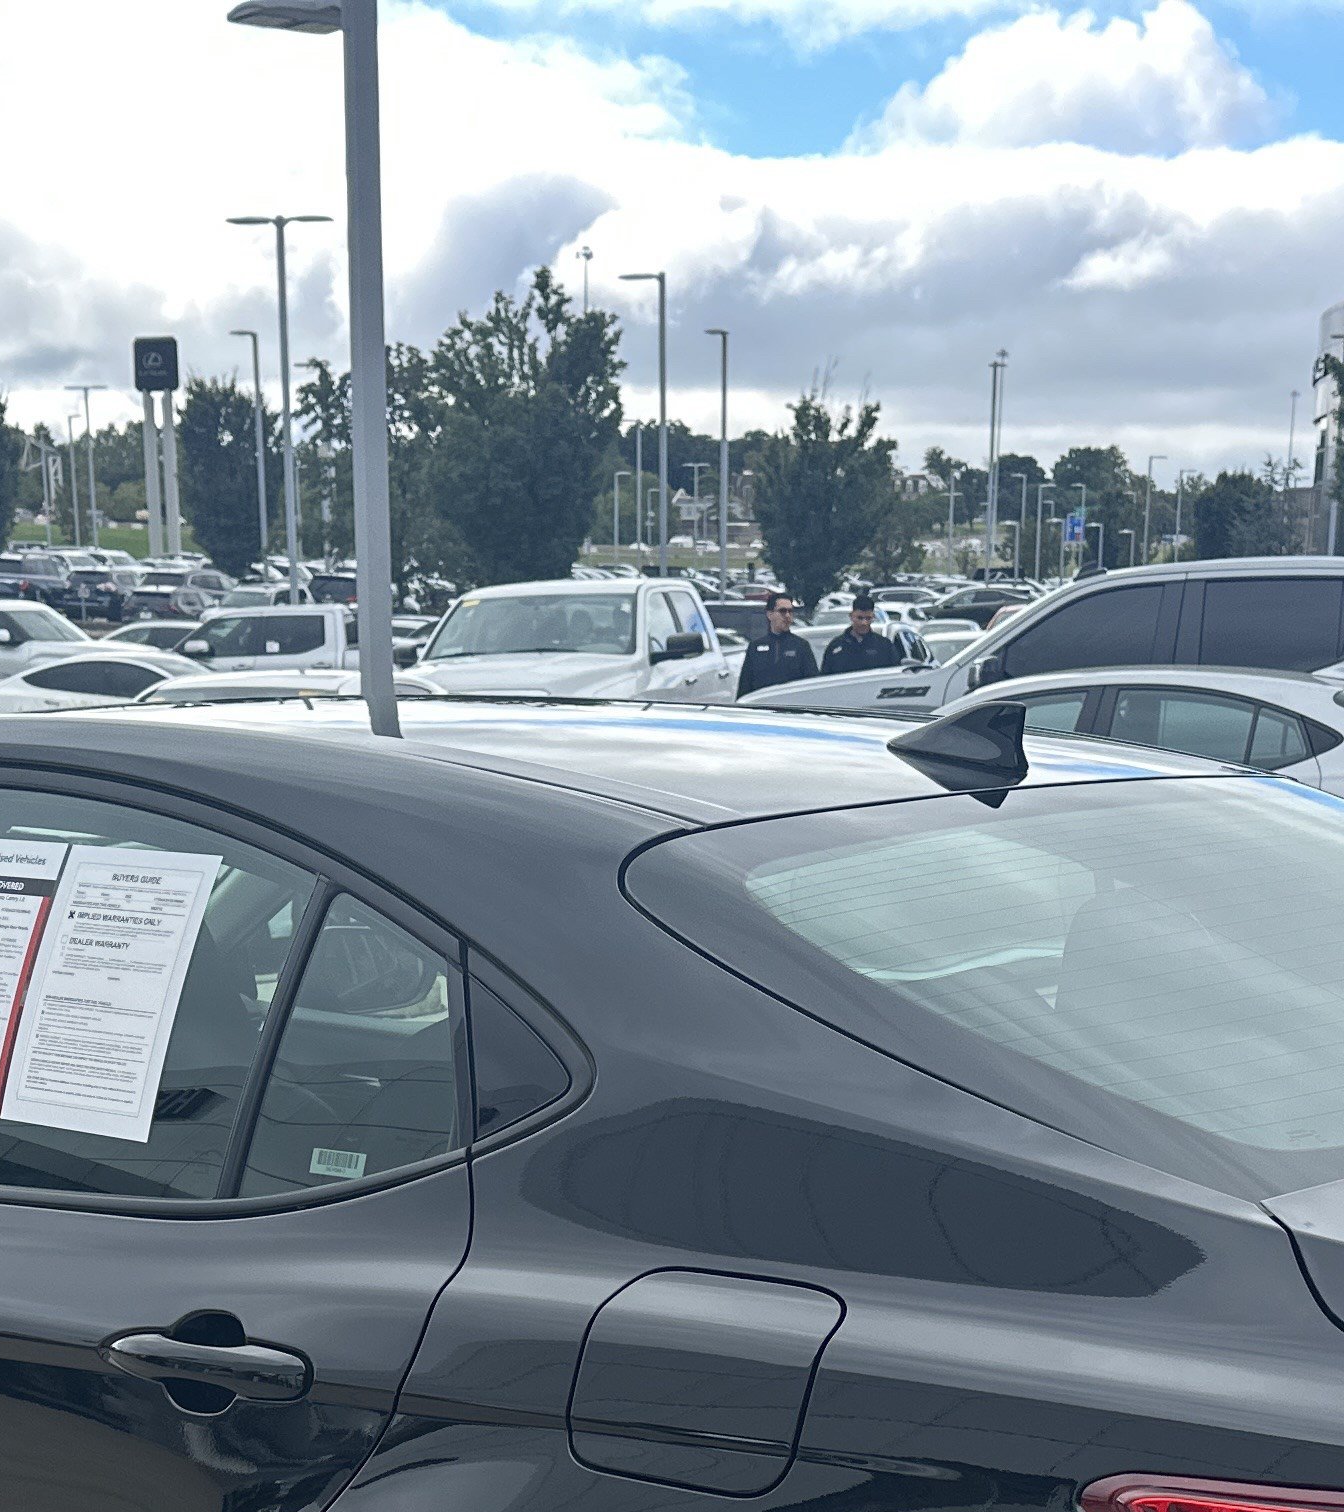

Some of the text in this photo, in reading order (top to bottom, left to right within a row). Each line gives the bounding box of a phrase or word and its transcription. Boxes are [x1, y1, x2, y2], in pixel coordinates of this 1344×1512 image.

[15, 854, 47, 866] Vehicles
[112, 873, 163, 885] BUYERS GUIDE
[77, 911, 162, 927] IMPLIED WARRANTIES ONLY
[69, 936, 131, 950] DEALER WARRANTY
